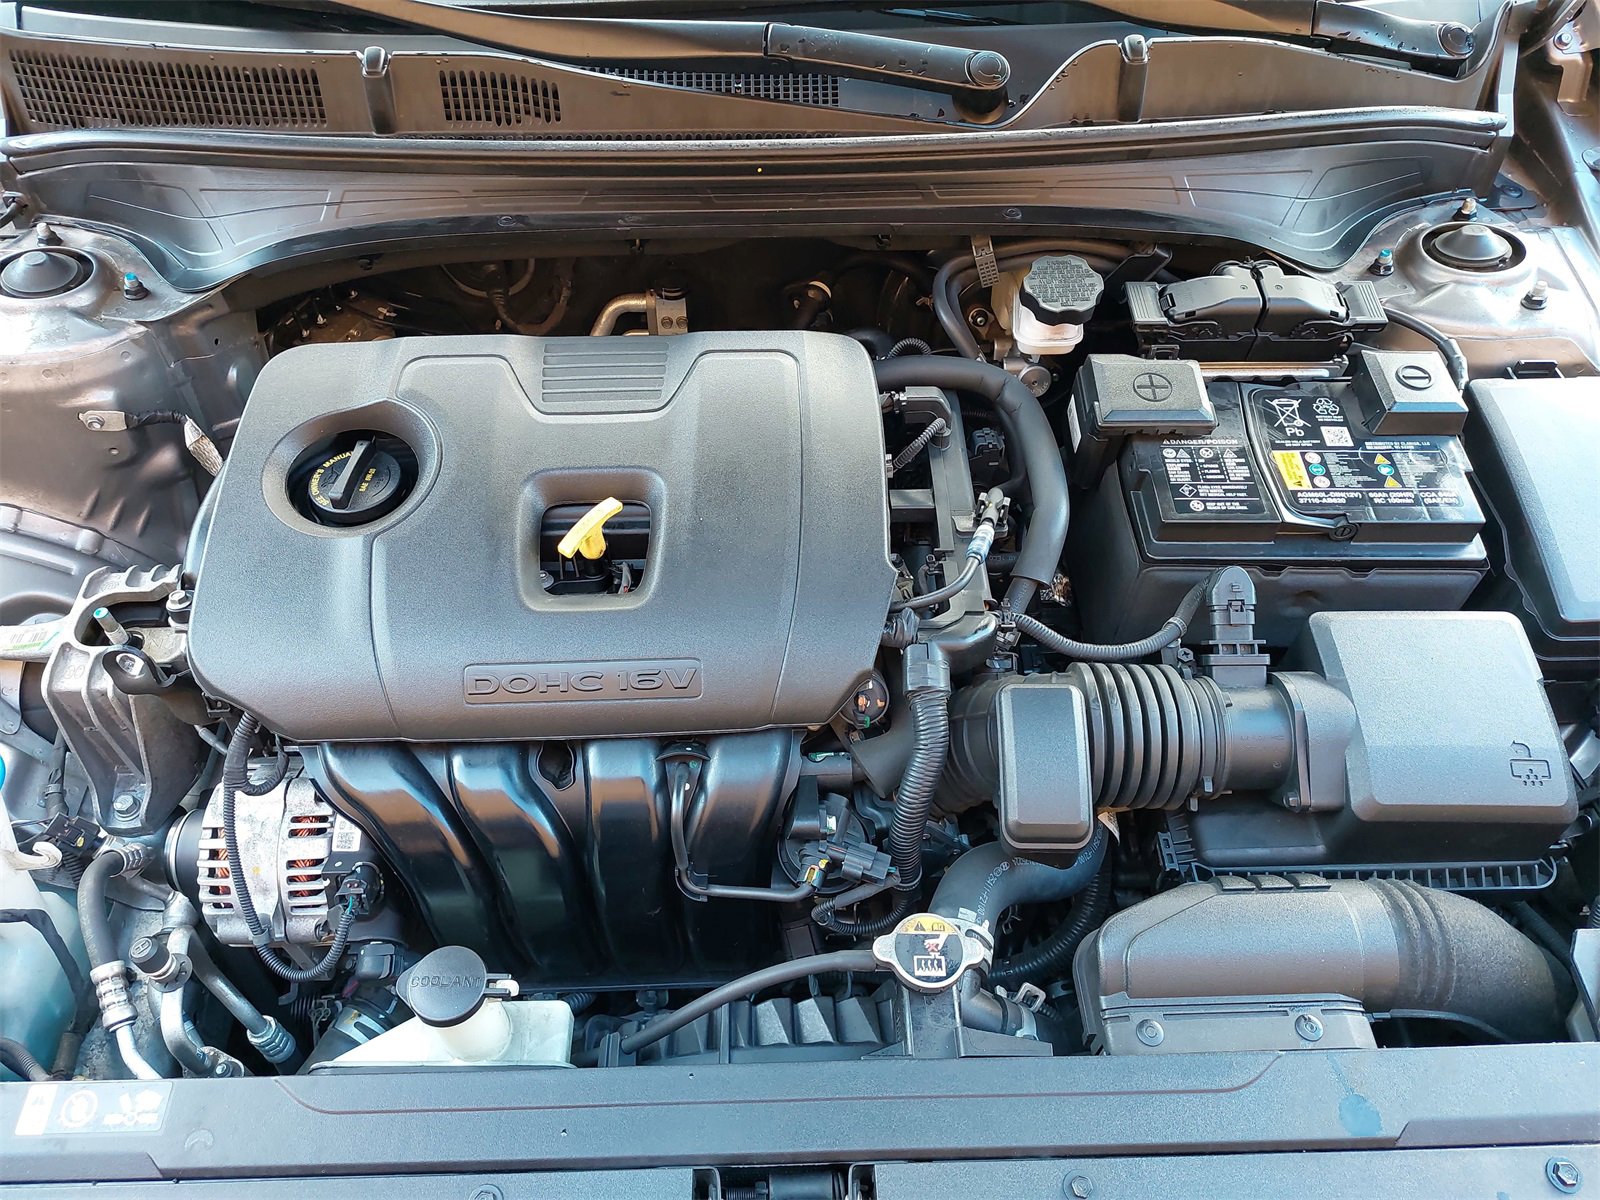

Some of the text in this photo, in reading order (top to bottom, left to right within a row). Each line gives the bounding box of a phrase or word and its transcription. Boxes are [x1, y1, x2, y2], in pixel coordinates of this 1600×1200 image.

[1285, 427, 1304, 436] Pb
[468, 668, 697, 695] DOHC 16V
[411, 975, 481, 988] COOLANT
